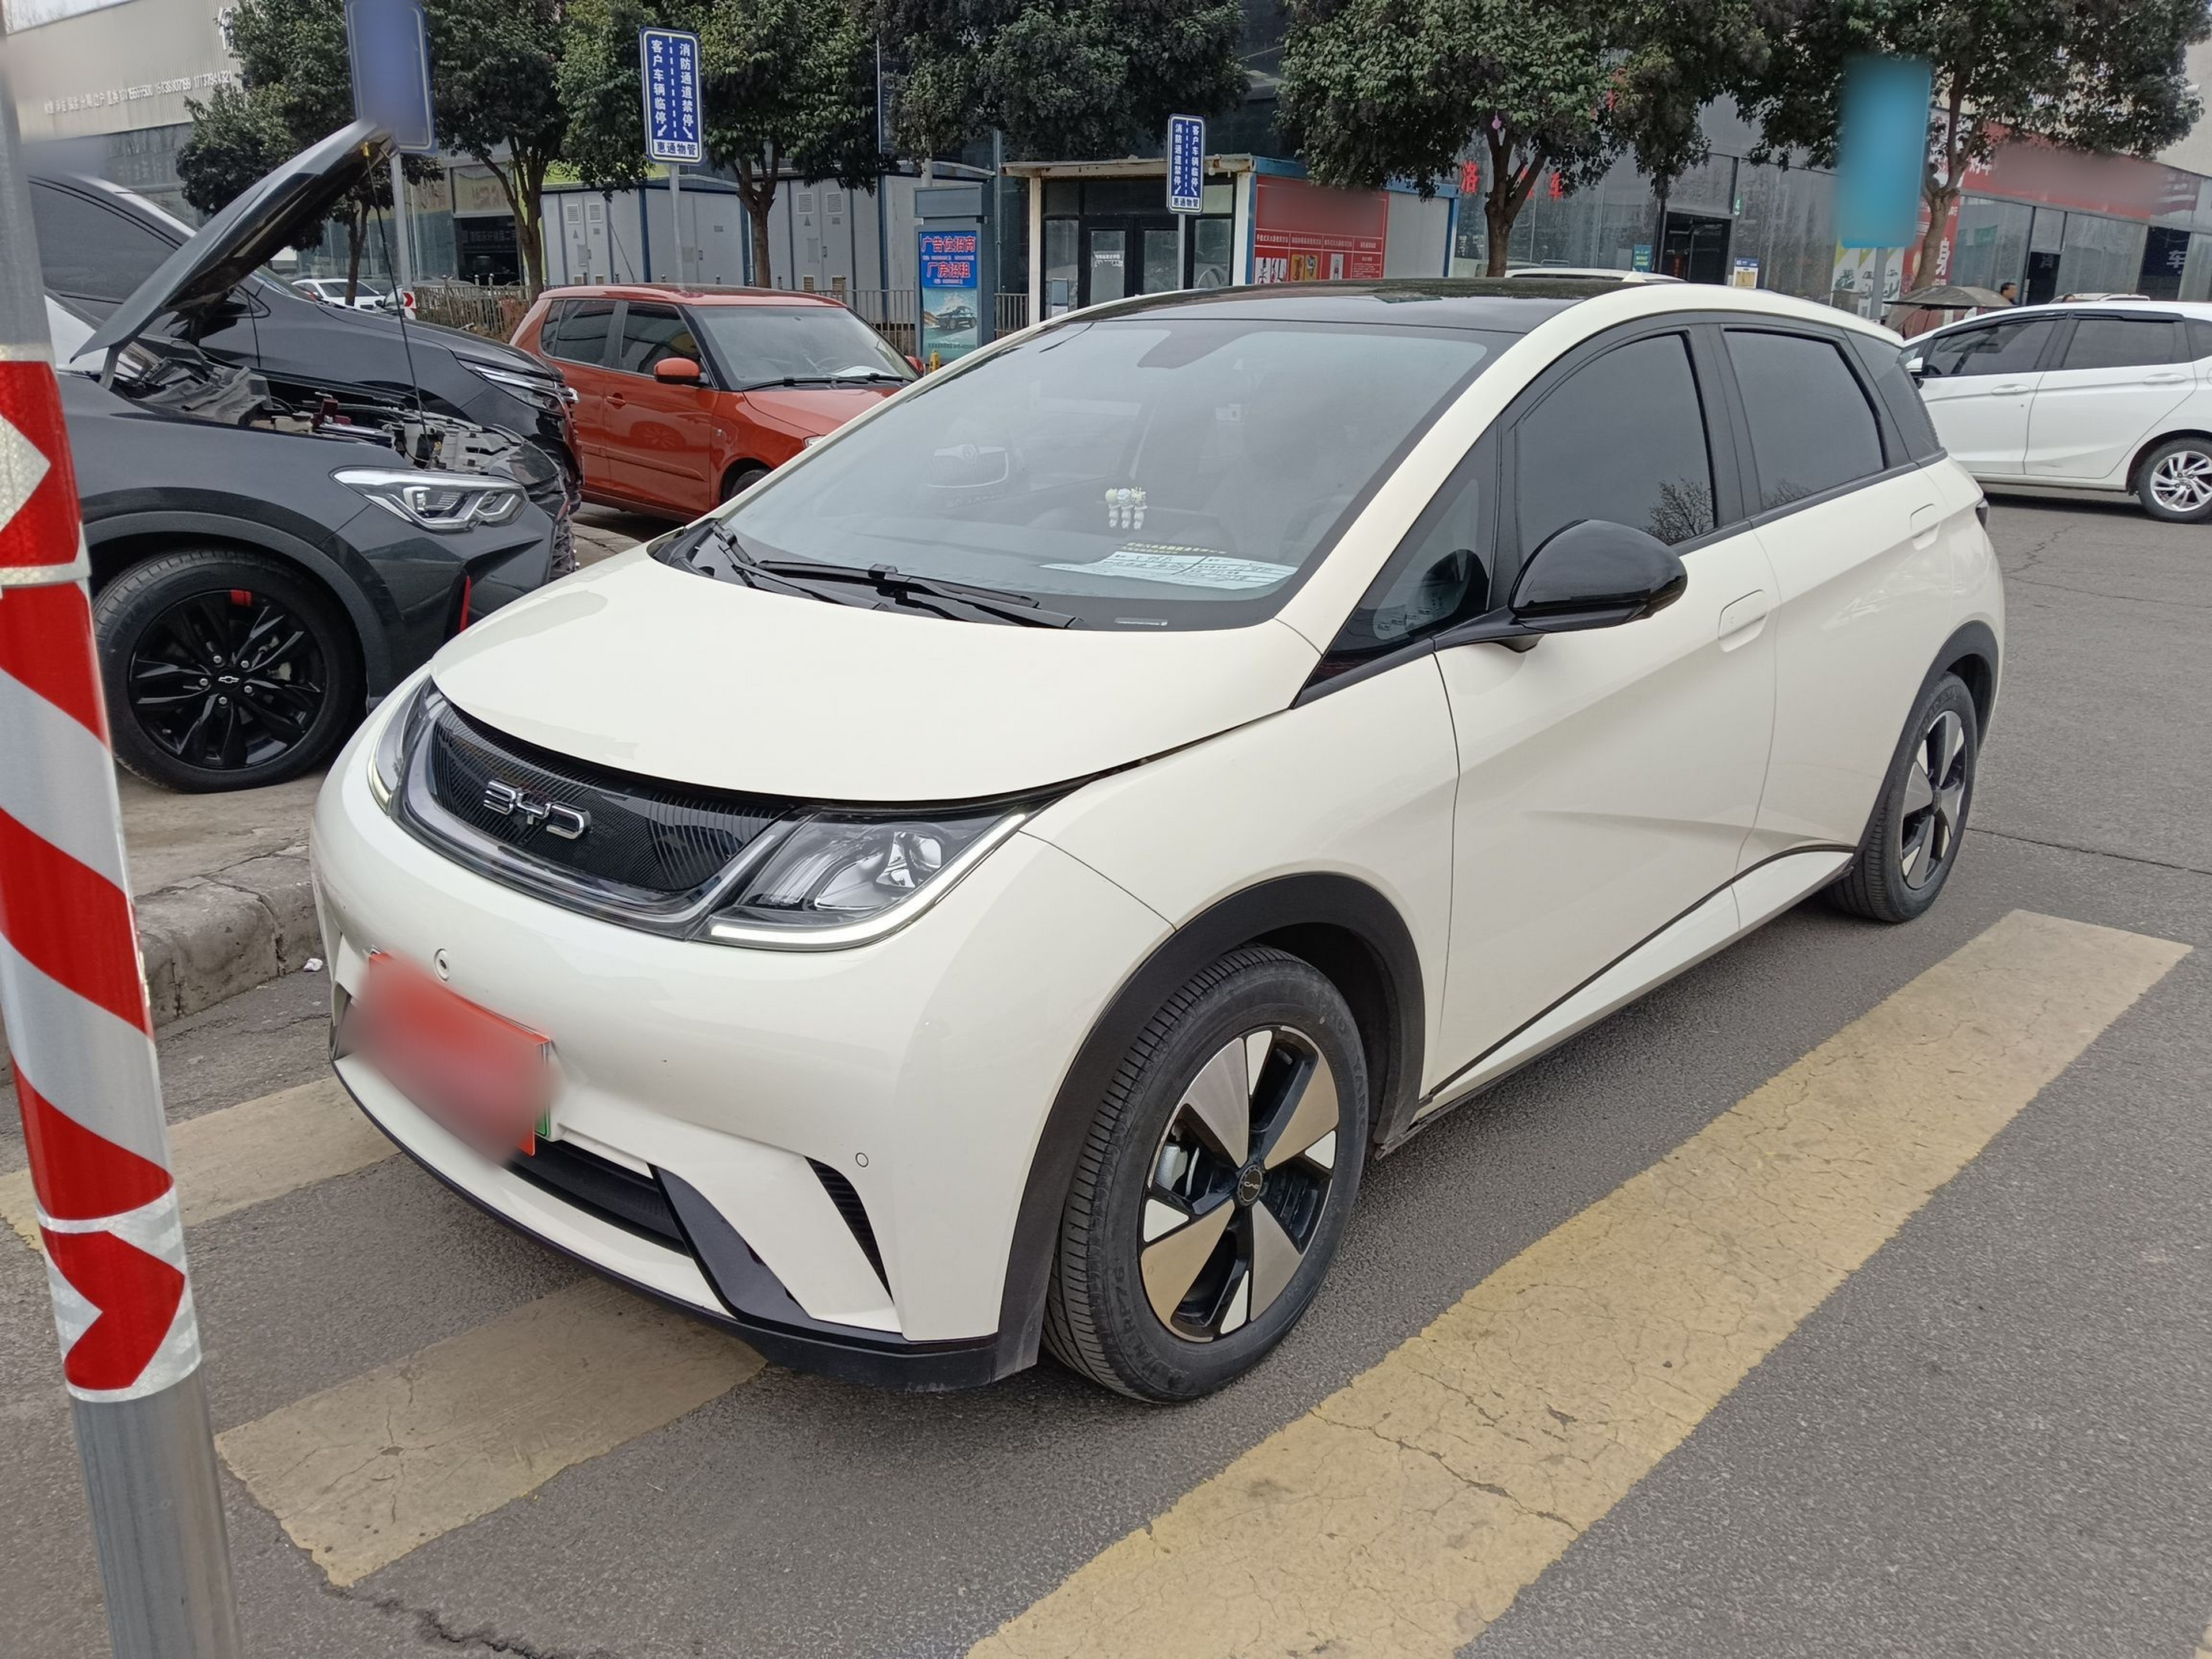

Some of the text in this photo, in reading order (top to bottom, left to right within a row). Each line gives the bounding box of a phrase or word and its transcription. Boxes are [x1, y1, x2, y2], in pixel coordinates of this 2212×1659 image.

[651, 40, 667, 125] 客户车辆临停
[679, 43, 694, 127] 消防通道禁停
[656, 141, 696, 156] 惠通物管
[1173, 123, 1183, 186] 消防通道禁停
[1191, 126, 1200, 187] 客户车辆临停
[1173, 197, 1199, 207] 惠通物管
[921, 236, 976, 253] 广告位招商
[926, 261, 971, 278] 厂房招租
[483, 778, 592, 840] BYD
